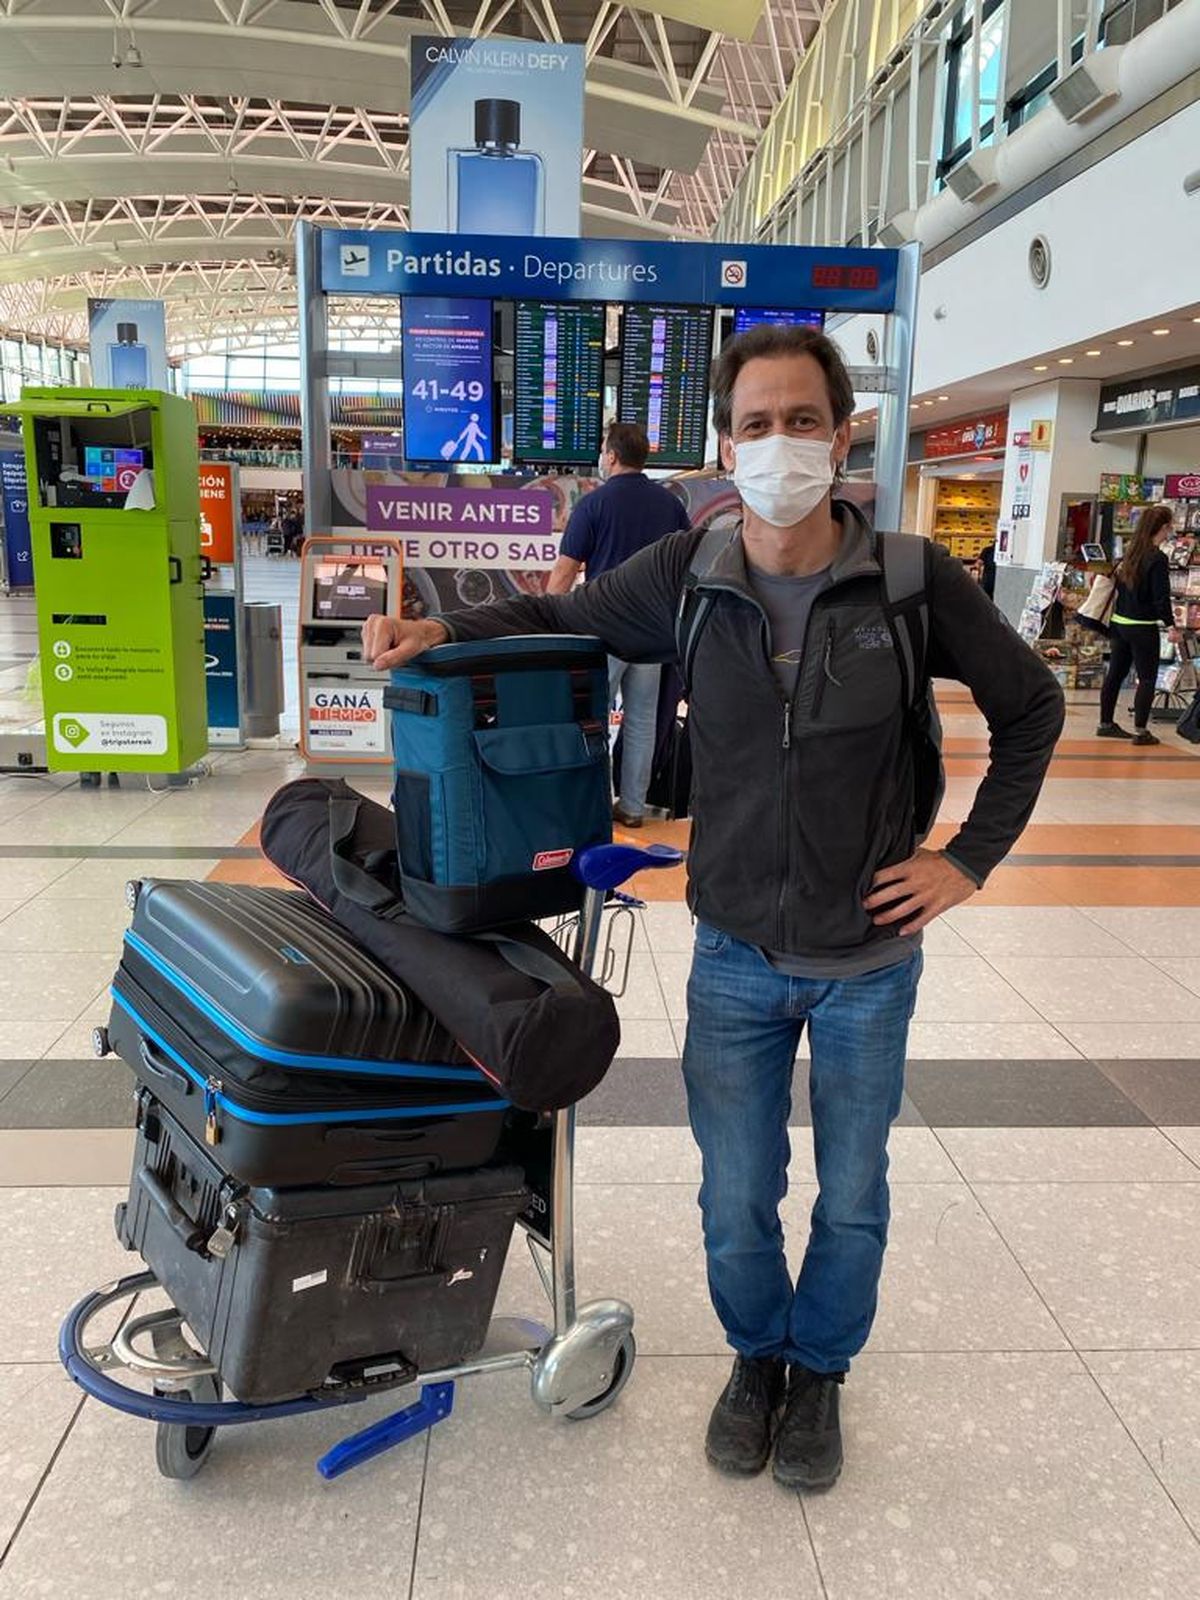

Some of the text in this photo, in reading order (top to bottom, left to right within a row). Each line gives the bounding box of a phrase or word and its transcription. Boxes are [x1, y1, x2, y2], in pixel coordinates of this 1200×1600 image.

[425, 46, 569, 70] CALVIN KLEIN DEFY
[386, 249, 658, 284] Partidas Departures
[412, 380, 484, 402] 41-49
[378, 500, 541, 523] VENIR ANTES
[428, 540, 499, 560] OTRO
[508, 543, 557, 561] SAB
[315, 691, 371, 708] GANÁ
[316, 709, 375, 721] TIEMPO
